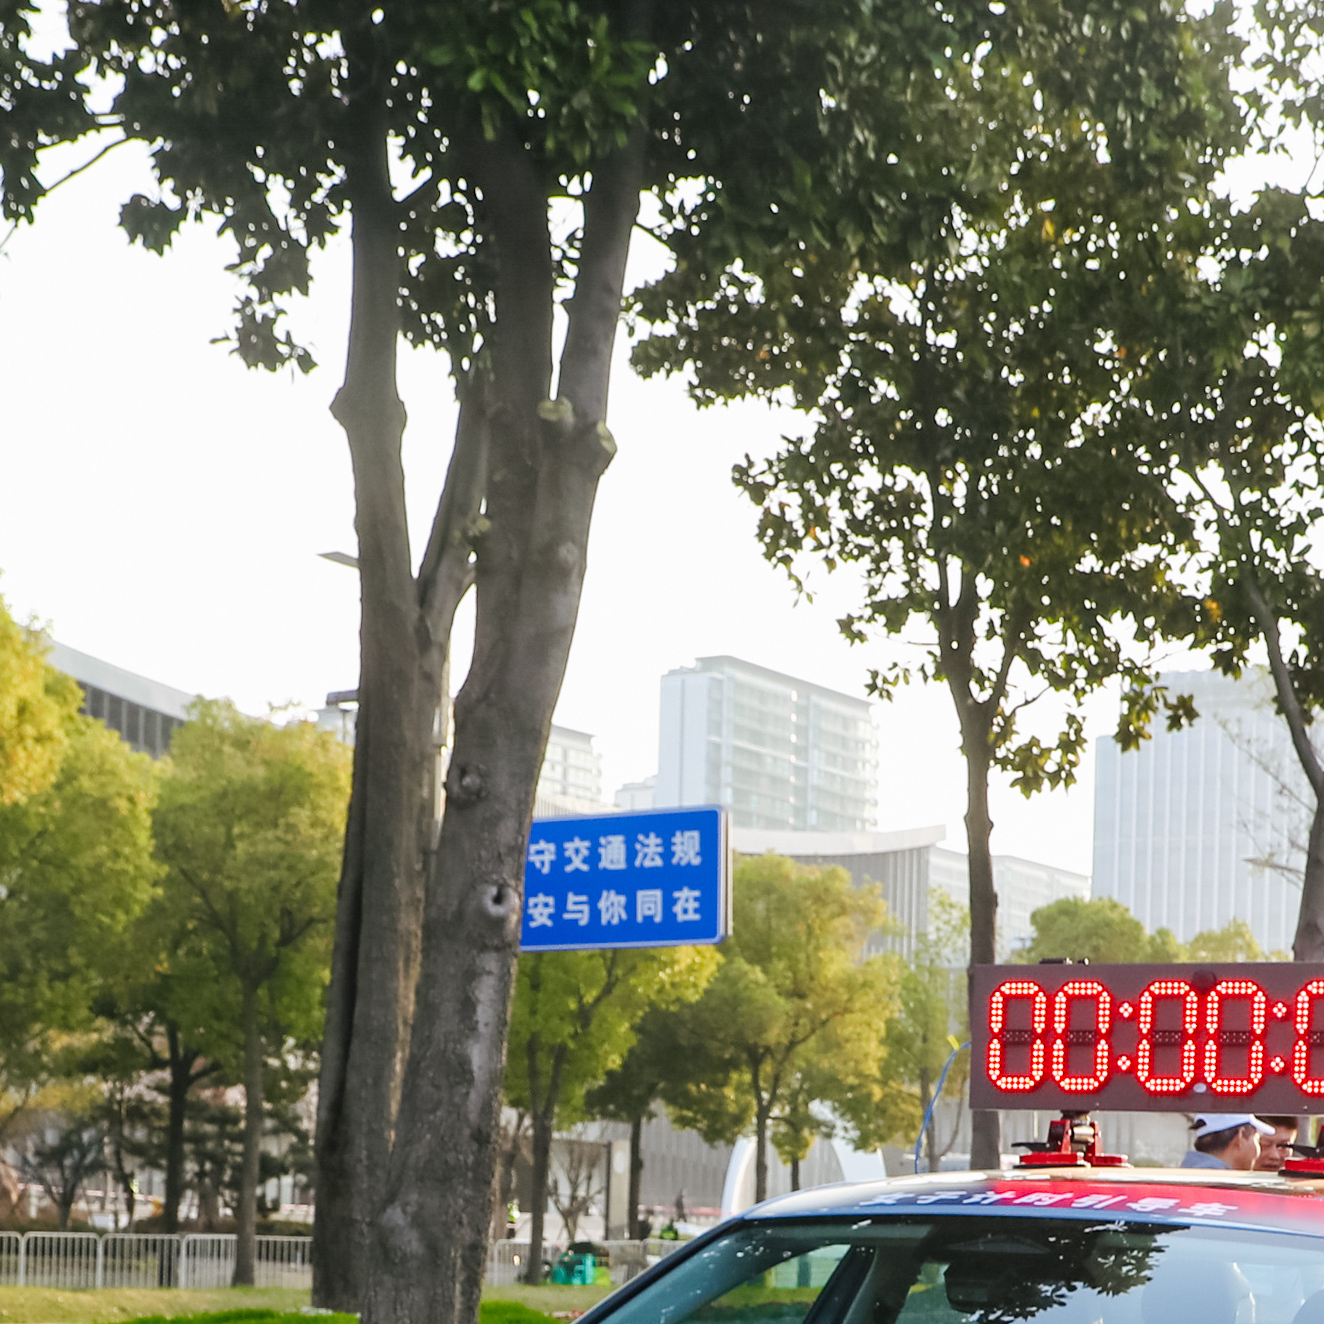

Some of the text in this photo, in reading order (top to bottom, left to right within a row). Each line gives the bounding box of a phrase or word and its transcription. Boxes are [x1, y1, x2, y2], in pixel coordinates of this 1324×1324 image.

[528, 830, 702, 874] 守交通法规
[527, 886, 701, 928] 安与你同在
[859, 1190, 1239, 1217] 女子计时引导车
